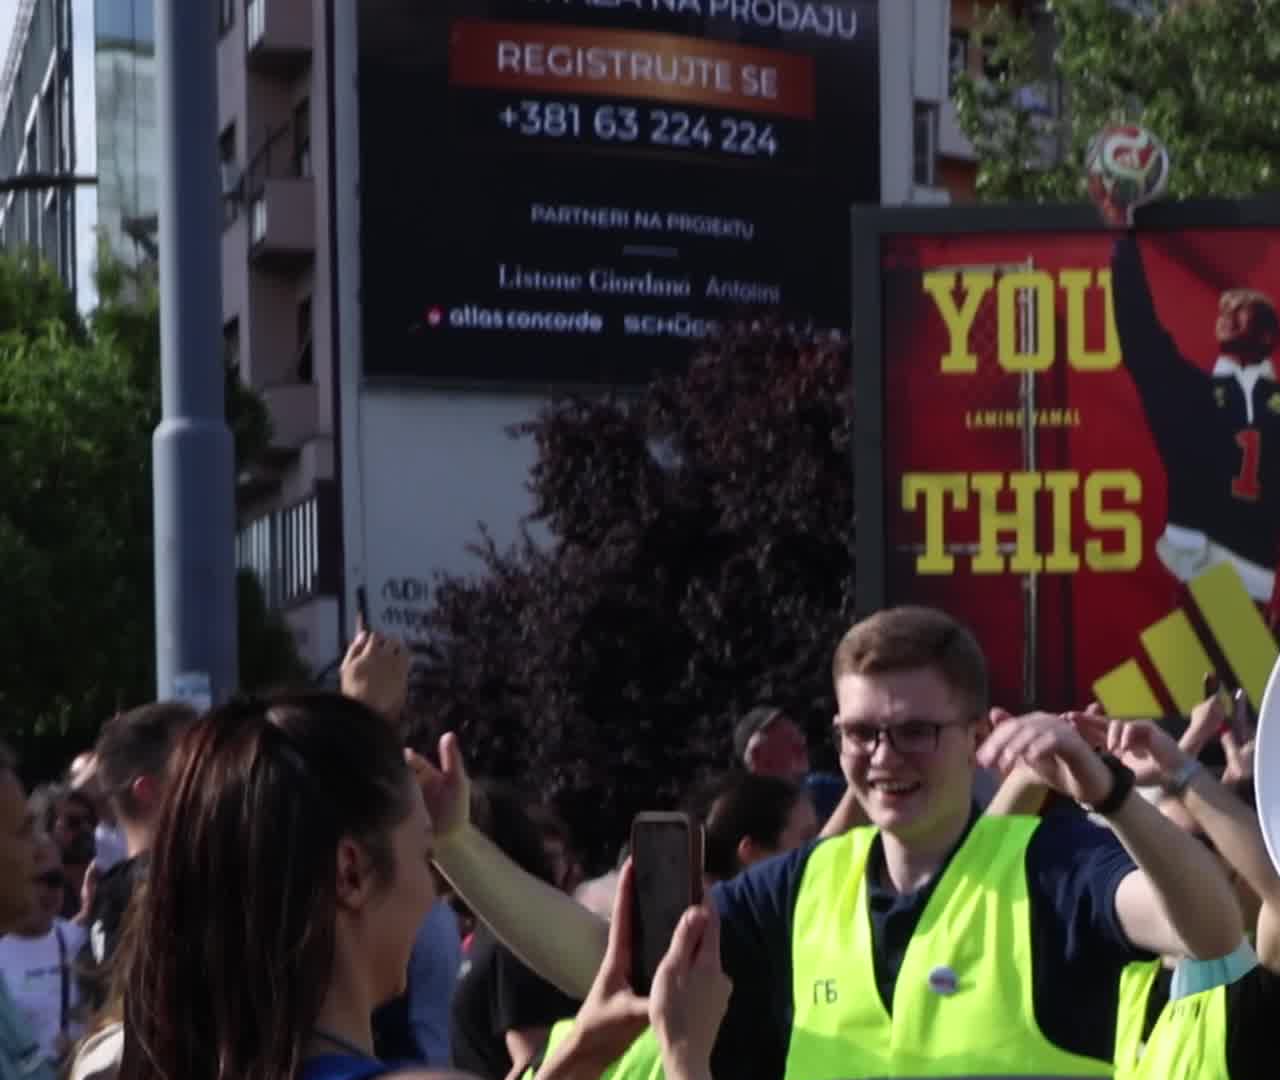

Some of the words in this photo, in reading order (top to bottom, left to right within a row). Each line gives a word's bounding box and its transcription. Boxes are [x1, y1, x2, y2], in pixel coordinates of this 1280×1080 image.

[709, 0, 858, 40] PRODAJU
[496, 40, 732, 92] REGISTRUJTE
[741, 64, 778, 98] SE
[499, 101, 581, 137] +381
[593, 105, 640, 141] 63
[650, 111, 712, 147] 224
[720, 119, 777, 156] 224
[530, 202, 630, 229] PARTNERI
[633, 207, 663, 230] NA
[666, 211, 756, 241] PROJEKTU
[497, 263, 582, 291] Listone
[589, 268, 691, 298] Giordano
[923, 267, 1124, 374] YOU
[965, 408, 1025, 429] LAMINE
[1231, 430, 1263, 499] 1
[901, 469, 1143, 575] THIS
